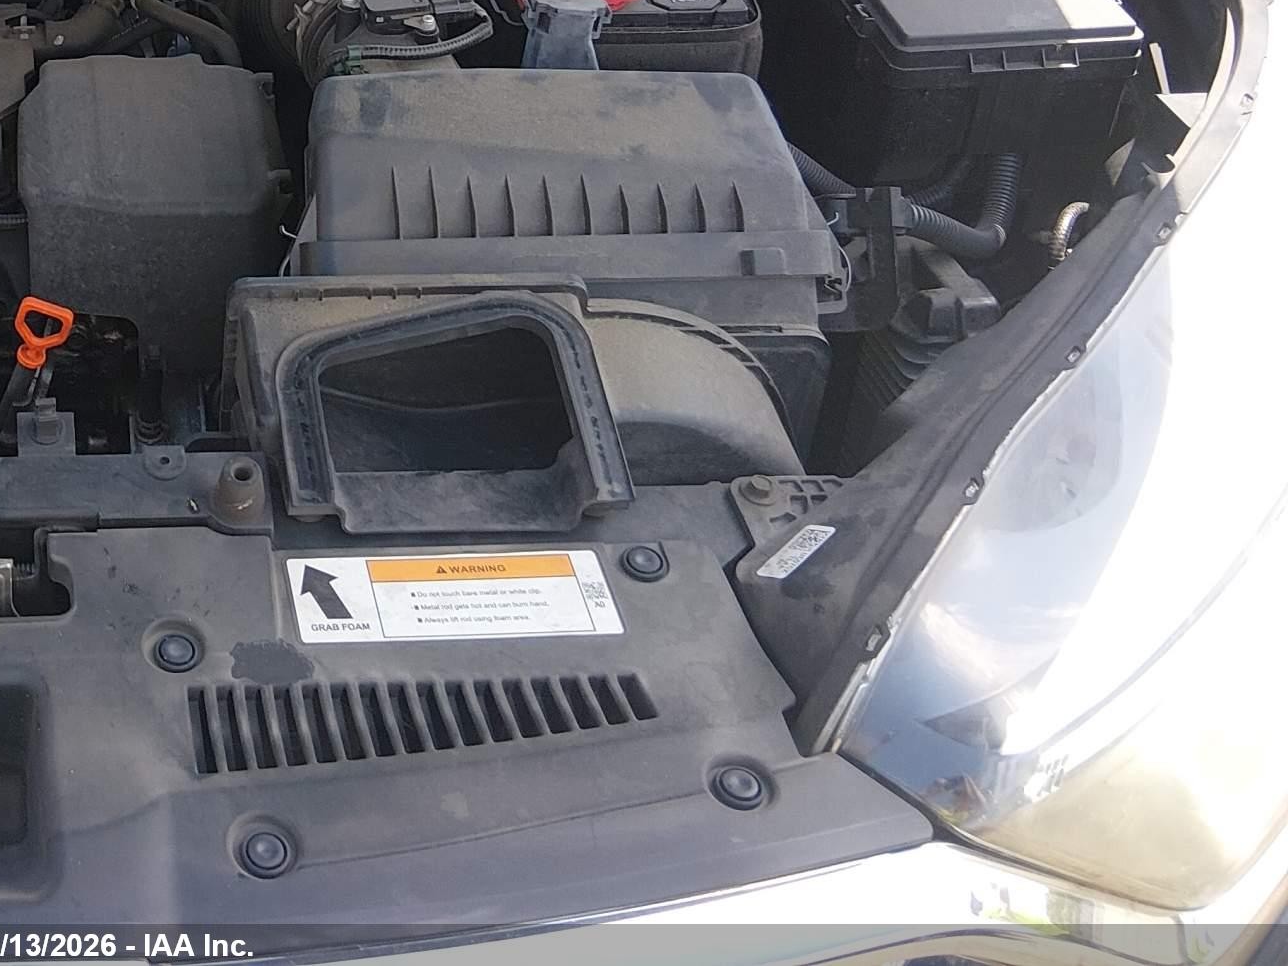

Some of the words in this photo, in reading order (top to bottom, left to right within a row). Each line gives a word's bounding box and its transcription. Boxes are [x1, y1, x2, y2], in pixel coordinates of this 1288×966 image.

[448, 564, 506, 574] WARNING
[311, 623, 339, 632] GRAB
[342, 622, 370, 631] FOAM
